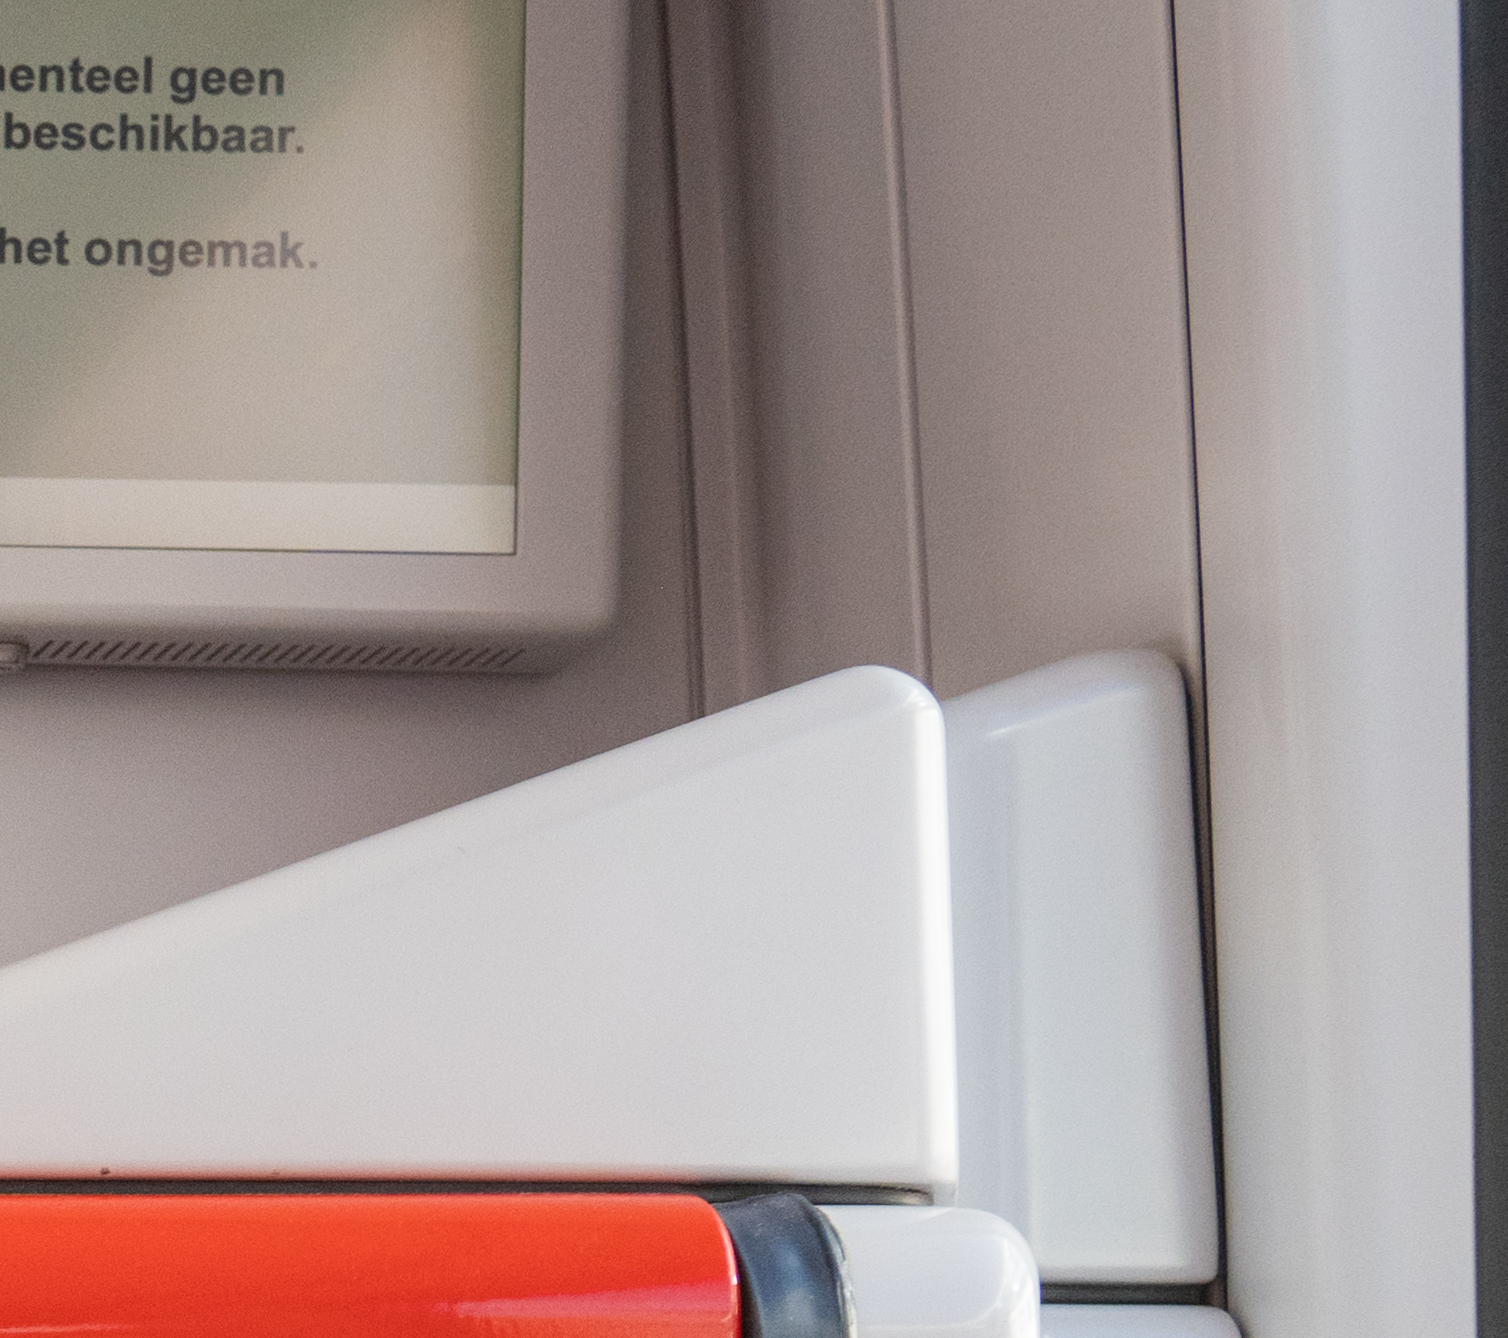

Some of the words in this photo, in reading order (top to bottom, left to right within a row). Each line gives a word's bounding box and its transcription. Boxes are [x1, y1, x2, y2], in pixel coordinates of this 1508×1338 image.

[170, 66, 285, 104] geen
[4, 112, 304, 154] beschikbaar.
[84, 230, 318, 277] ongemak.
